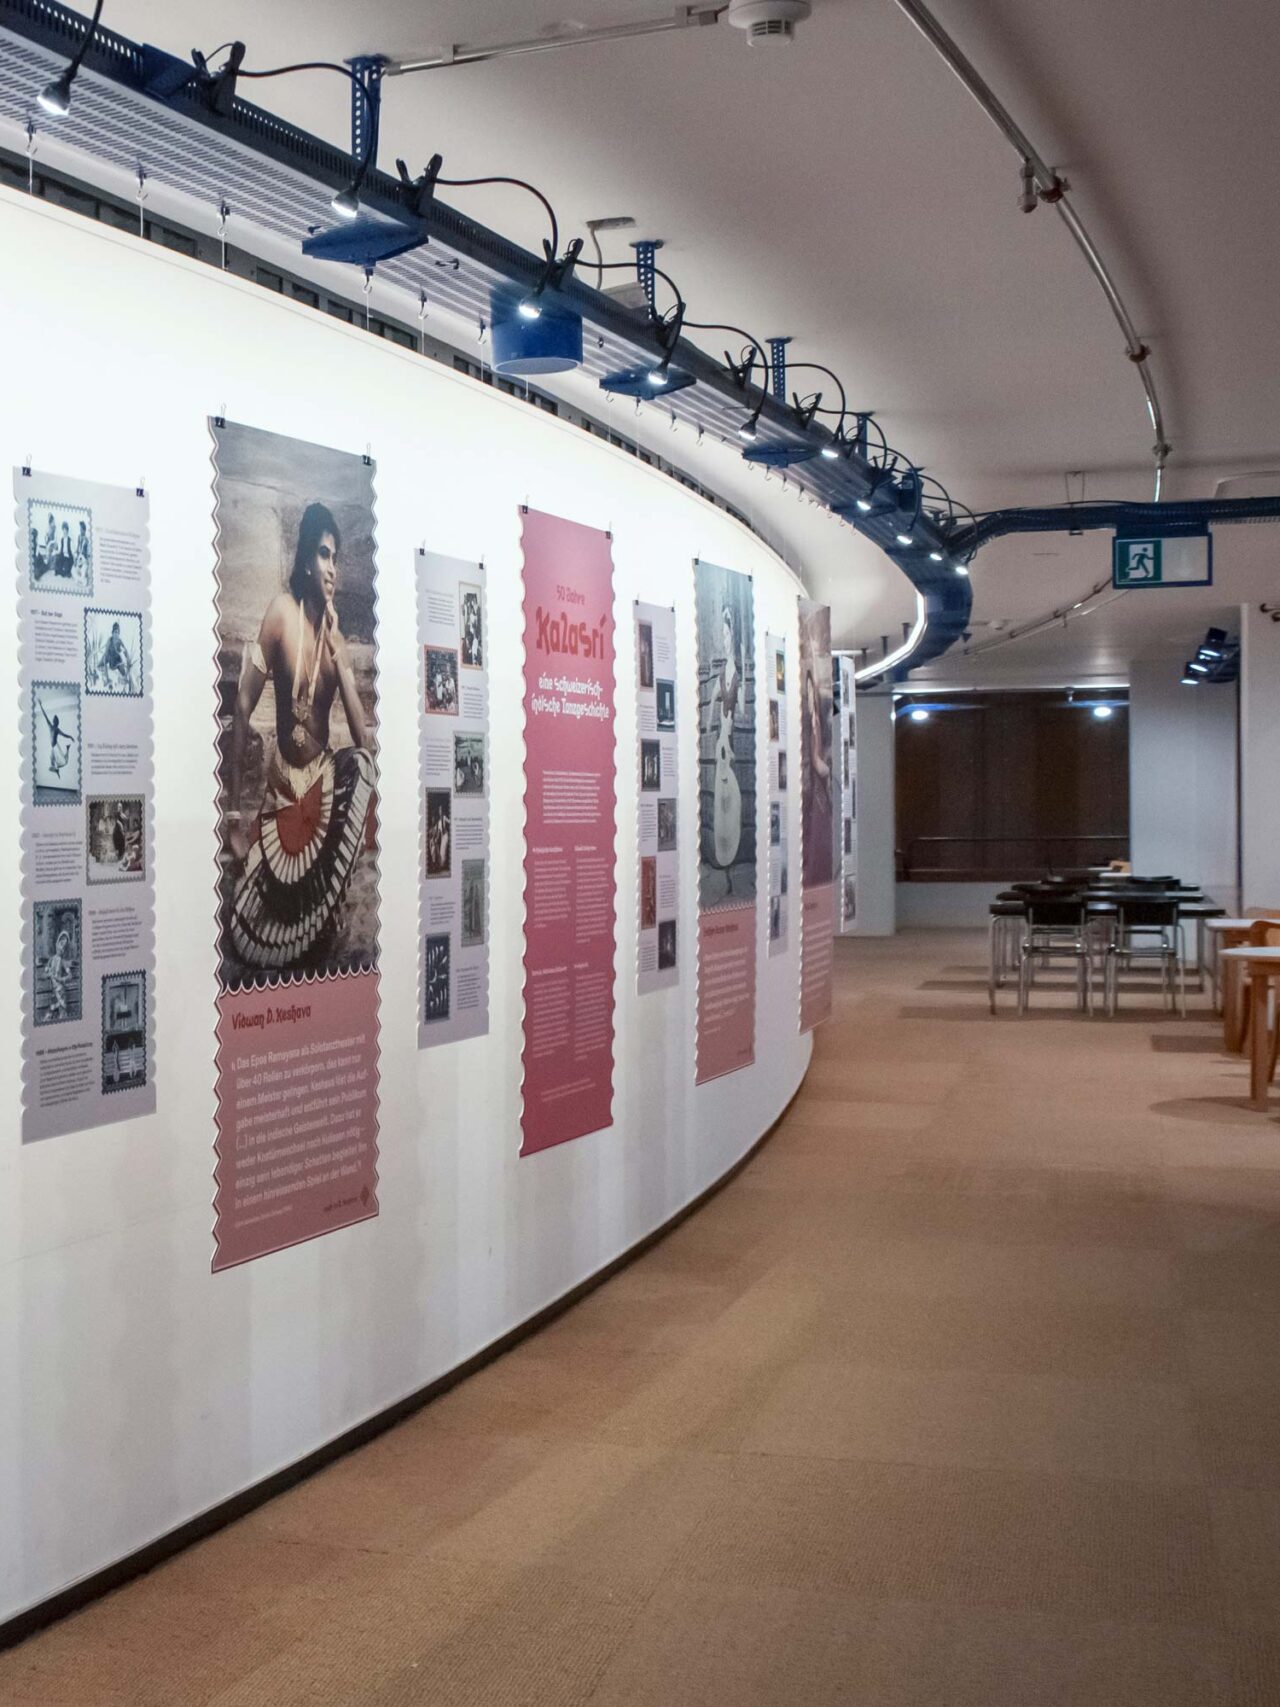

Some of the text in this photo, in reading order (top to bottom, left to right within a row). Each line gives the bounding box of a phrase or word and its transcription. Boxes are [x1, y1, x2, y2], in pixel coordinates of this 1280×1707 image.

[538, 672, 554, 691] eine
[531, 692, 610, 722] indische Tanzgeschichte
[231, 1004, 312, 1031] Vidwan D. Keshava
